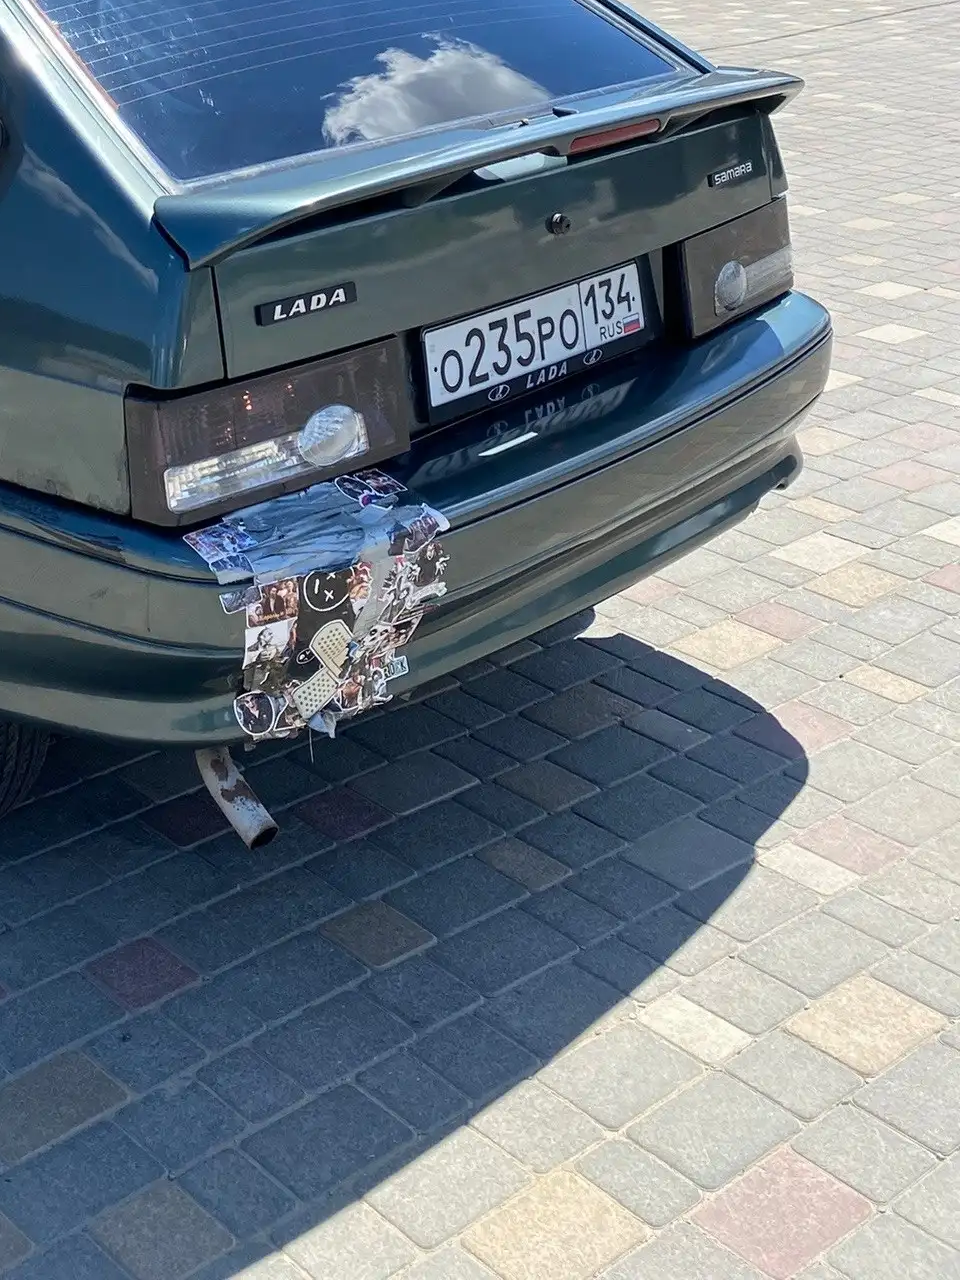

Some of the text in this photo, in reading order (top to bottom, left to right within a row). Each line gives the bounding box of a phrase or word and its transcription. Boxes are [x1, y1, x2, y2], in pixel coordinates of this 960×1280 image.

[273, 288, 347, 321] LADA
[584, 273, 633, 324] 134
[599, 320, 623, 340] RUS
[526, 361, 568, 389] LADA
